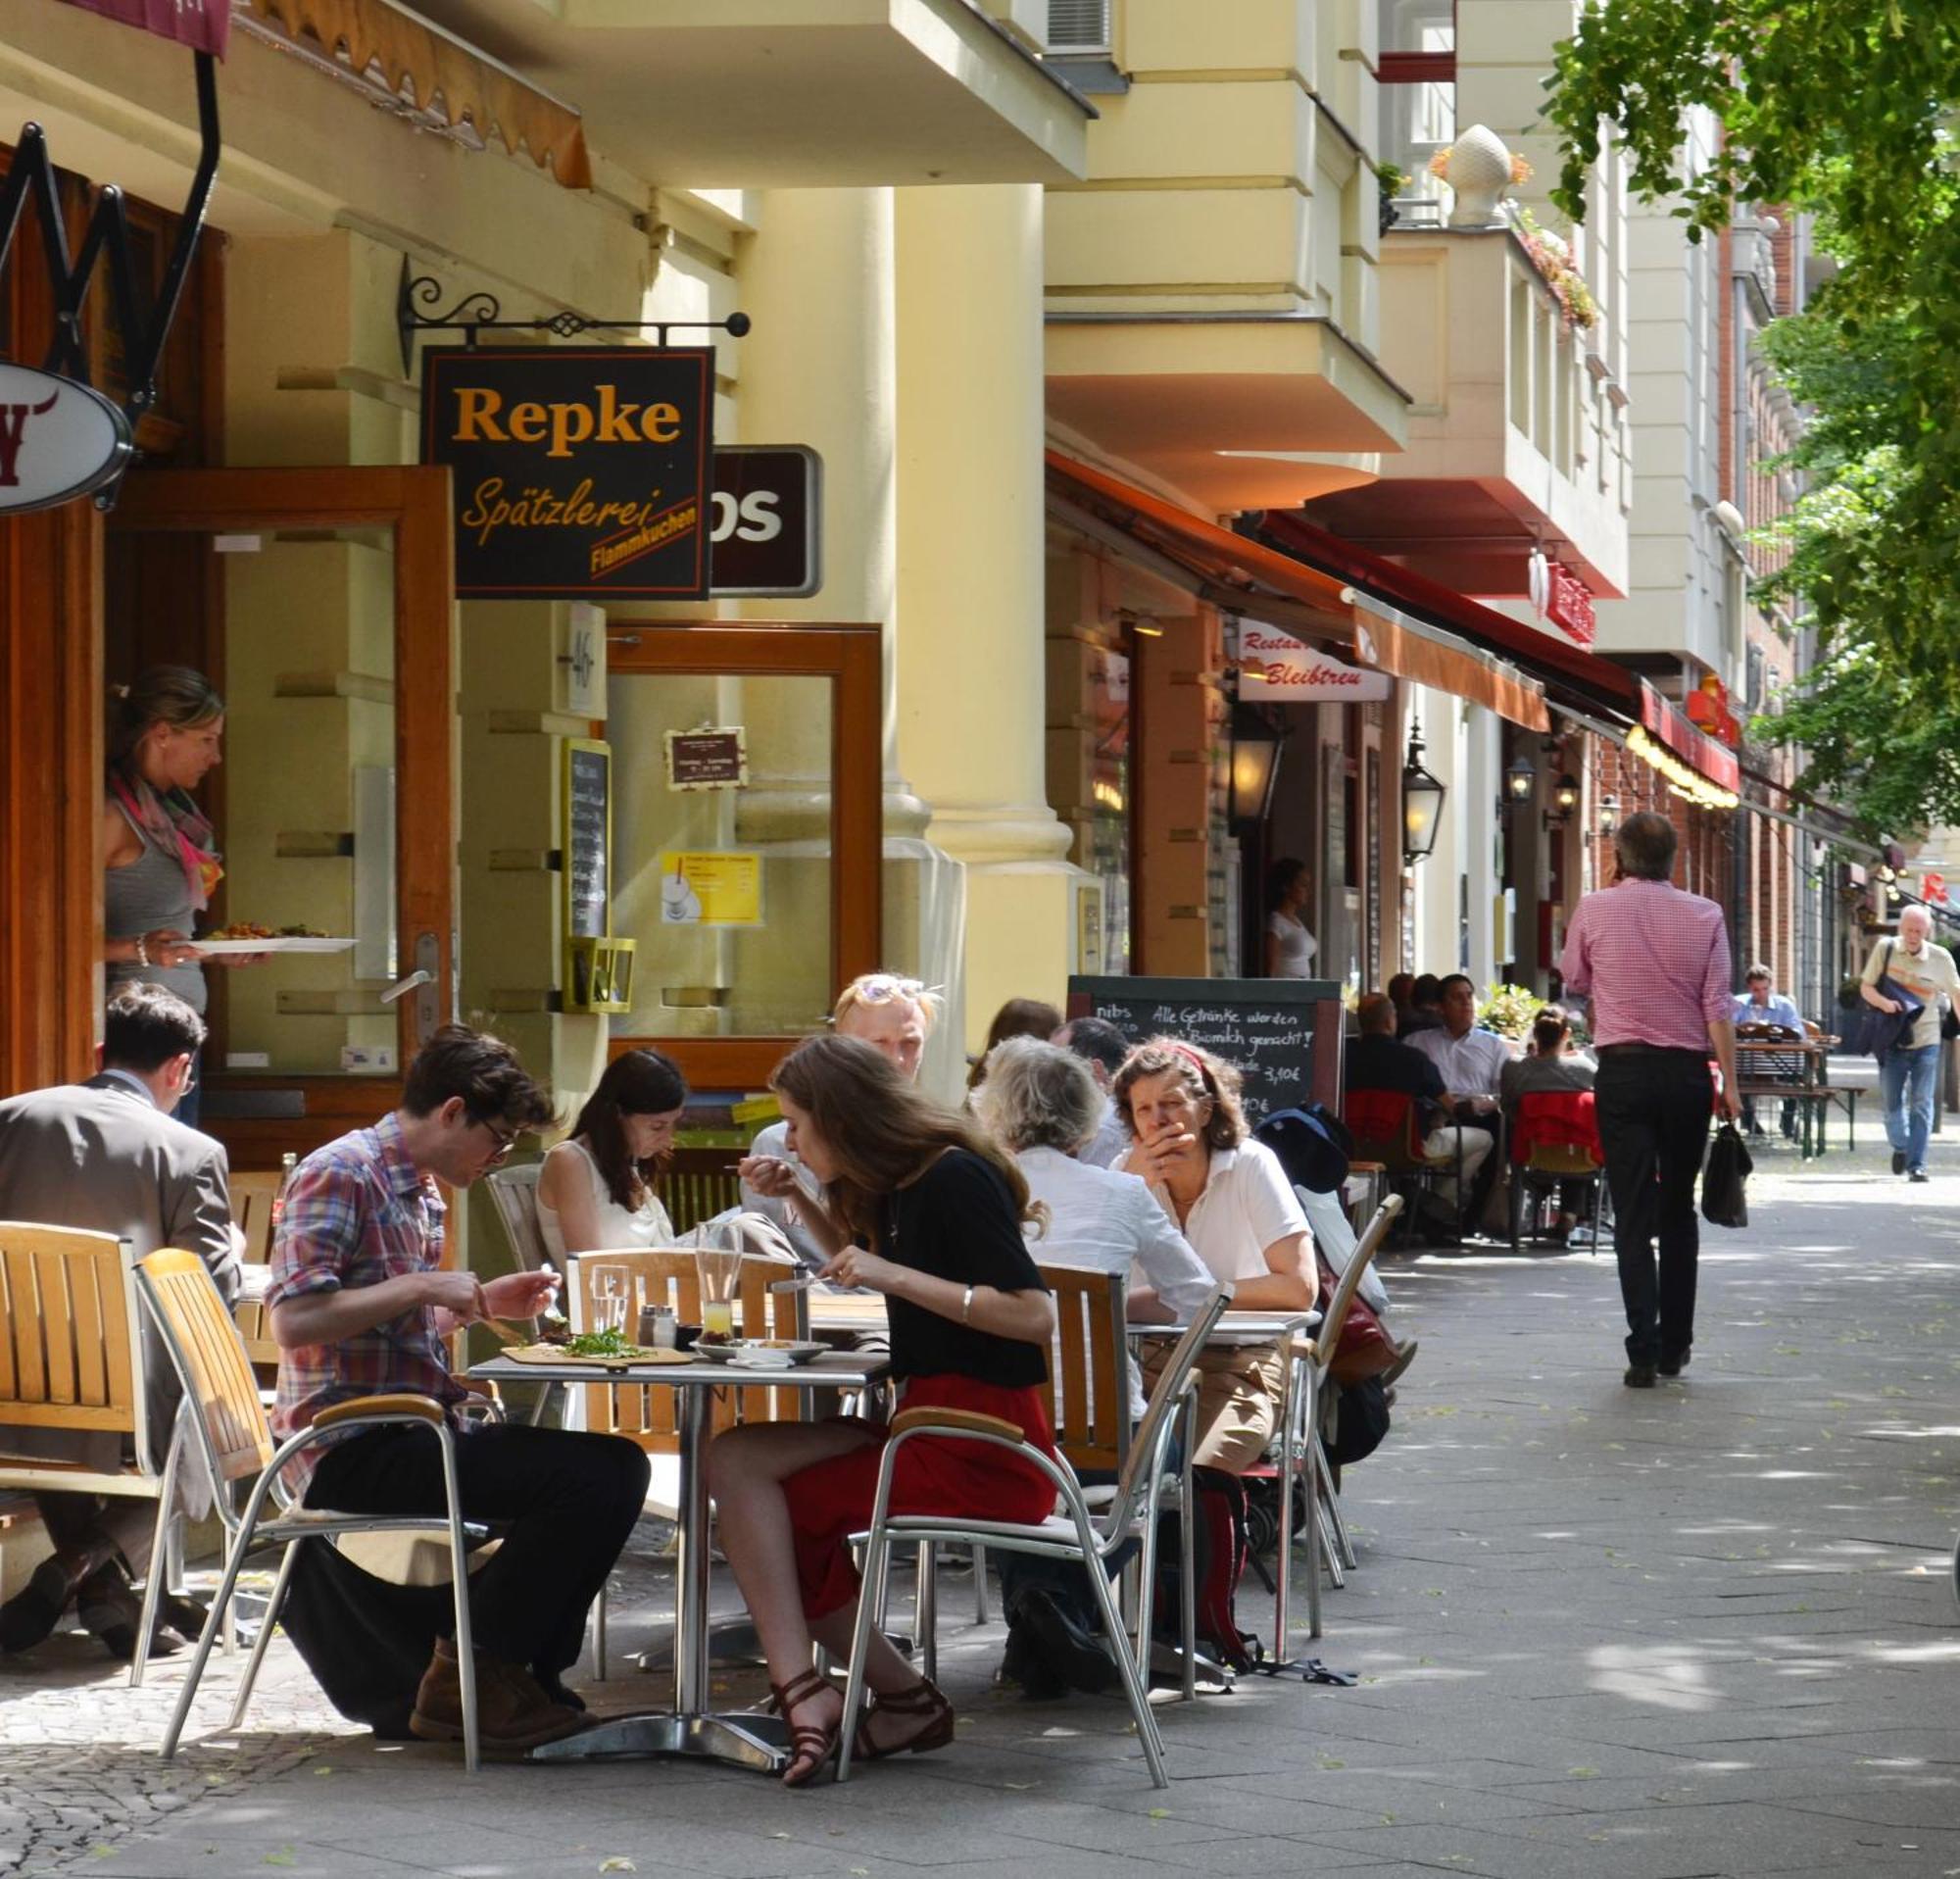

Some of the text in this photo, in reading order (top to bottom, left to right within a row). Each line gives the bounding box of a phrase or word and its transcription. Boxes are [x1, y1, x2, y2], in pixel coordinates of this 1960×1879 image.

[452, 384, 681, 457] Repke
[463, 477, 661, 547] Spätzlerei
[591, 507, 698, 573] Flammkuchen
[1264, 663, 1362, 685] Bleibtreu
[1152, 1005, 1178, 1024] Alle
